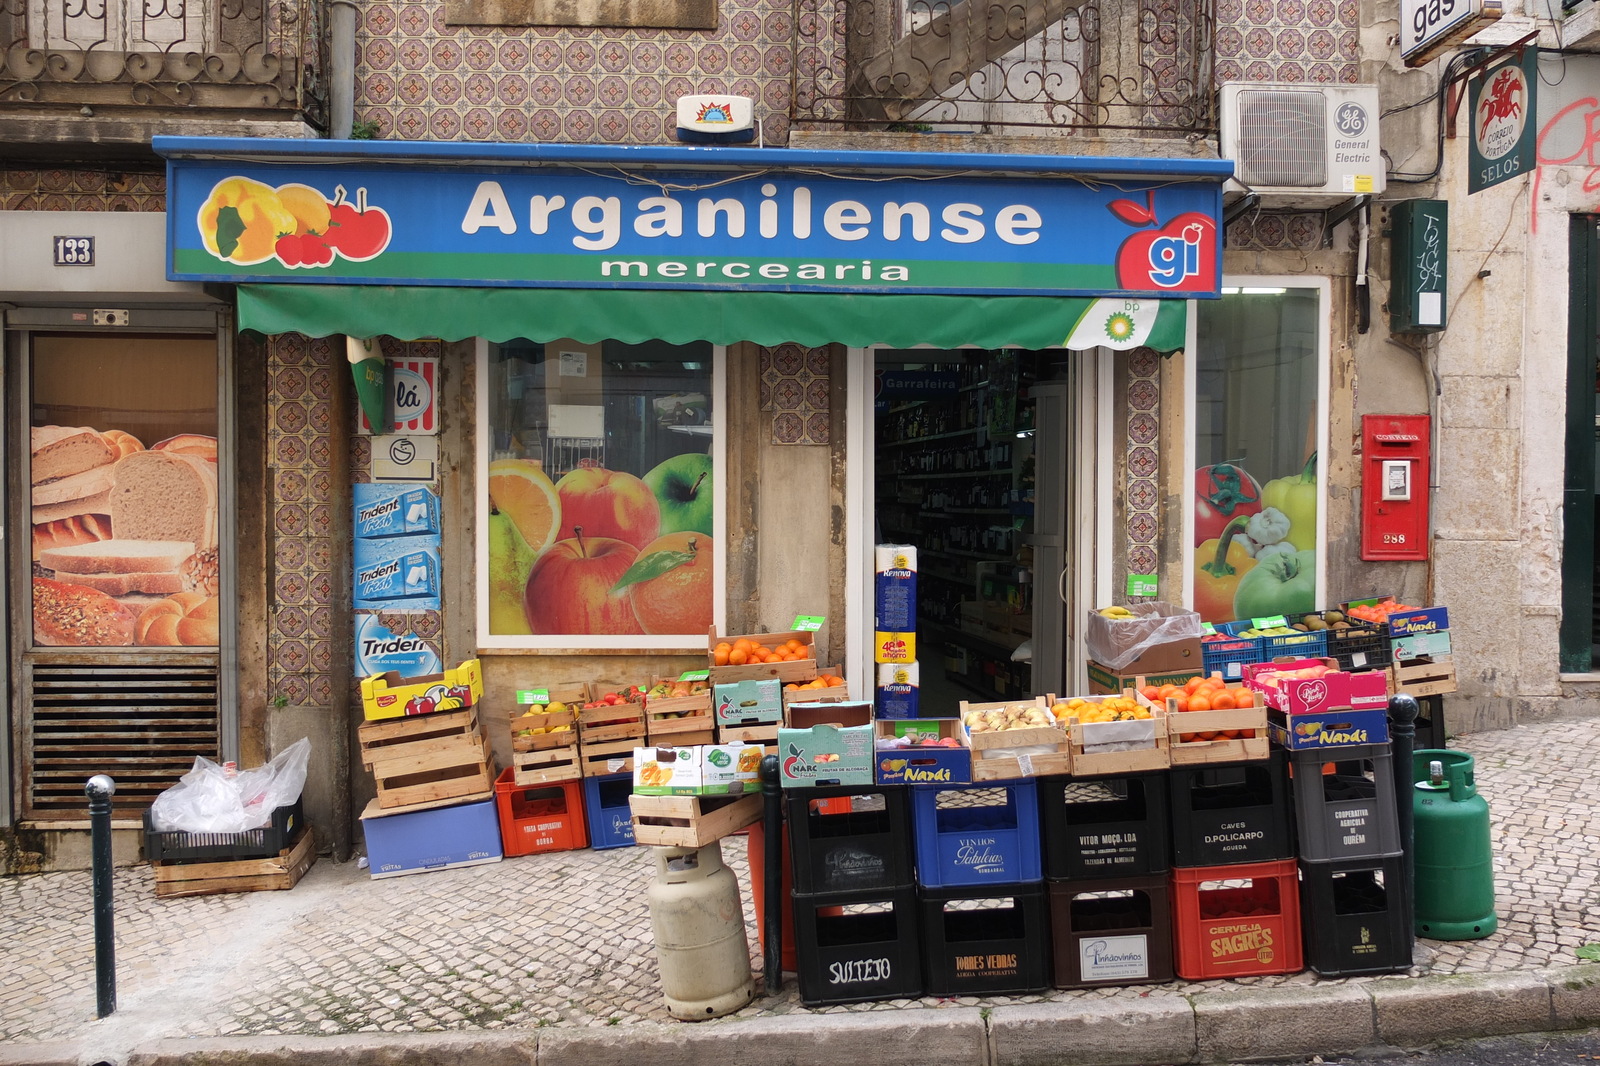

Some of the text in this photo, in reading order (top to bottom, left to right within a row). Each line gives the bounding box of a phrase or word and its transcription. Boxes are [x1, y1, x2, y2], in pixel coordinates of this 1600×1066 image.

[1414, 0, 1455, 43] gas
[1334, 139, 1370, 149] General
[1485, 136, 1516, 157] PORTUGAL
[1335, 152, 1370, 163] Electric
[1481, 155, 1520, 185] SELOS
[461, 181, 1043, 252] Arganilense
[57, 238, 91, 264] 133
[602, 260, 909, 282] mercearia
[1124, 300, 1140, 314] bp
[886, 379, 956, 389] Garrafeira
[394, 381, 421, 408] lá
[359, 498, 399, 522] Trident
[1383, 534, 1406, 544] 288
[359, 560, 399, 584] Trident
[884, 569, 911, 577] Renova
[1406, 621, 1437, 632] Nardi
[363, 637, 424, 656] Triden
[882, 641, 895, 651] 48
[884, 684, 912, 692] Renova
[1319, 729, 1367, 745] Nardi
[793, 765, 818, 773] NARC
[904, 768, 951, 781] Nardi
[1335, 809, 1369, 820] COOPERATIVA
[1221, 822, 1246, 830] CAVES
[1340, 818, 1366, 827] AGRICOLA
[959, 838, 996, 847] VINHOS
[1079, 835, 1099, 845] VITOR
[1124, 833, 1137, 843] LDA
[1204, 831, 1264, 843] D.POLICARPO
[1343, 834, 1366, 845] OURÉM
[1209, 923, 1262, 935] CERVEJA
[1210, 928, 1274, 958] SAGRES
[955, 954, 1017, 971] TORRES VEDRAS
[829, 958, 891, 984] SULTEJO
